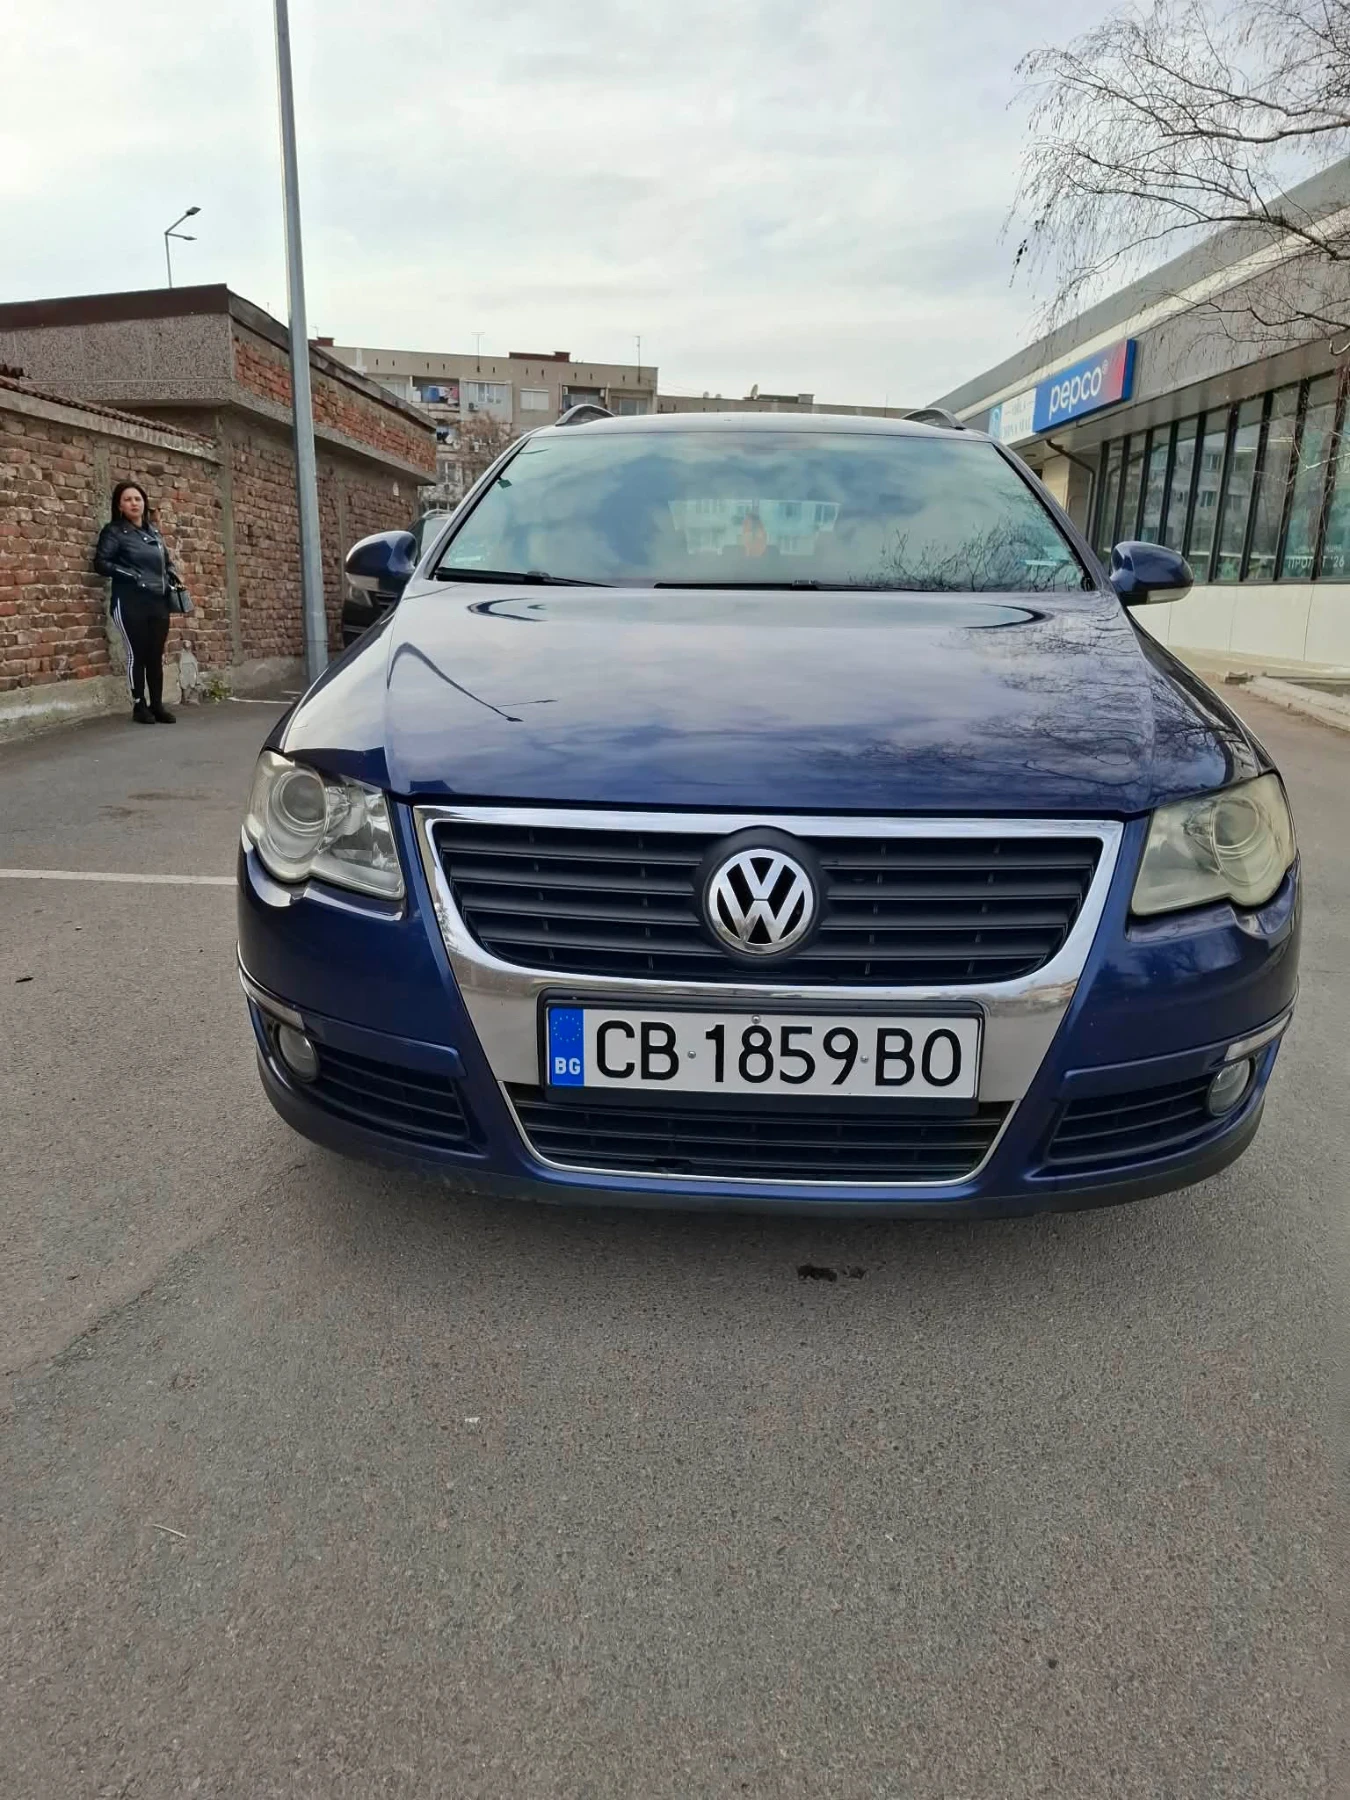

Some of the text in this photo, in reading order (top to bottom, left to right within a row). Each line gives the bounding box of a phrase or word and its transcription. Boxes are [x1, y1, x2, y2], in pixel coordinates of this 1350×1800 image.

[1049, 367, 1101, 420] pepco
[554, 1056, 581, 1075] BG
[596, 1019, 961, 1087] CB 1859 BO
